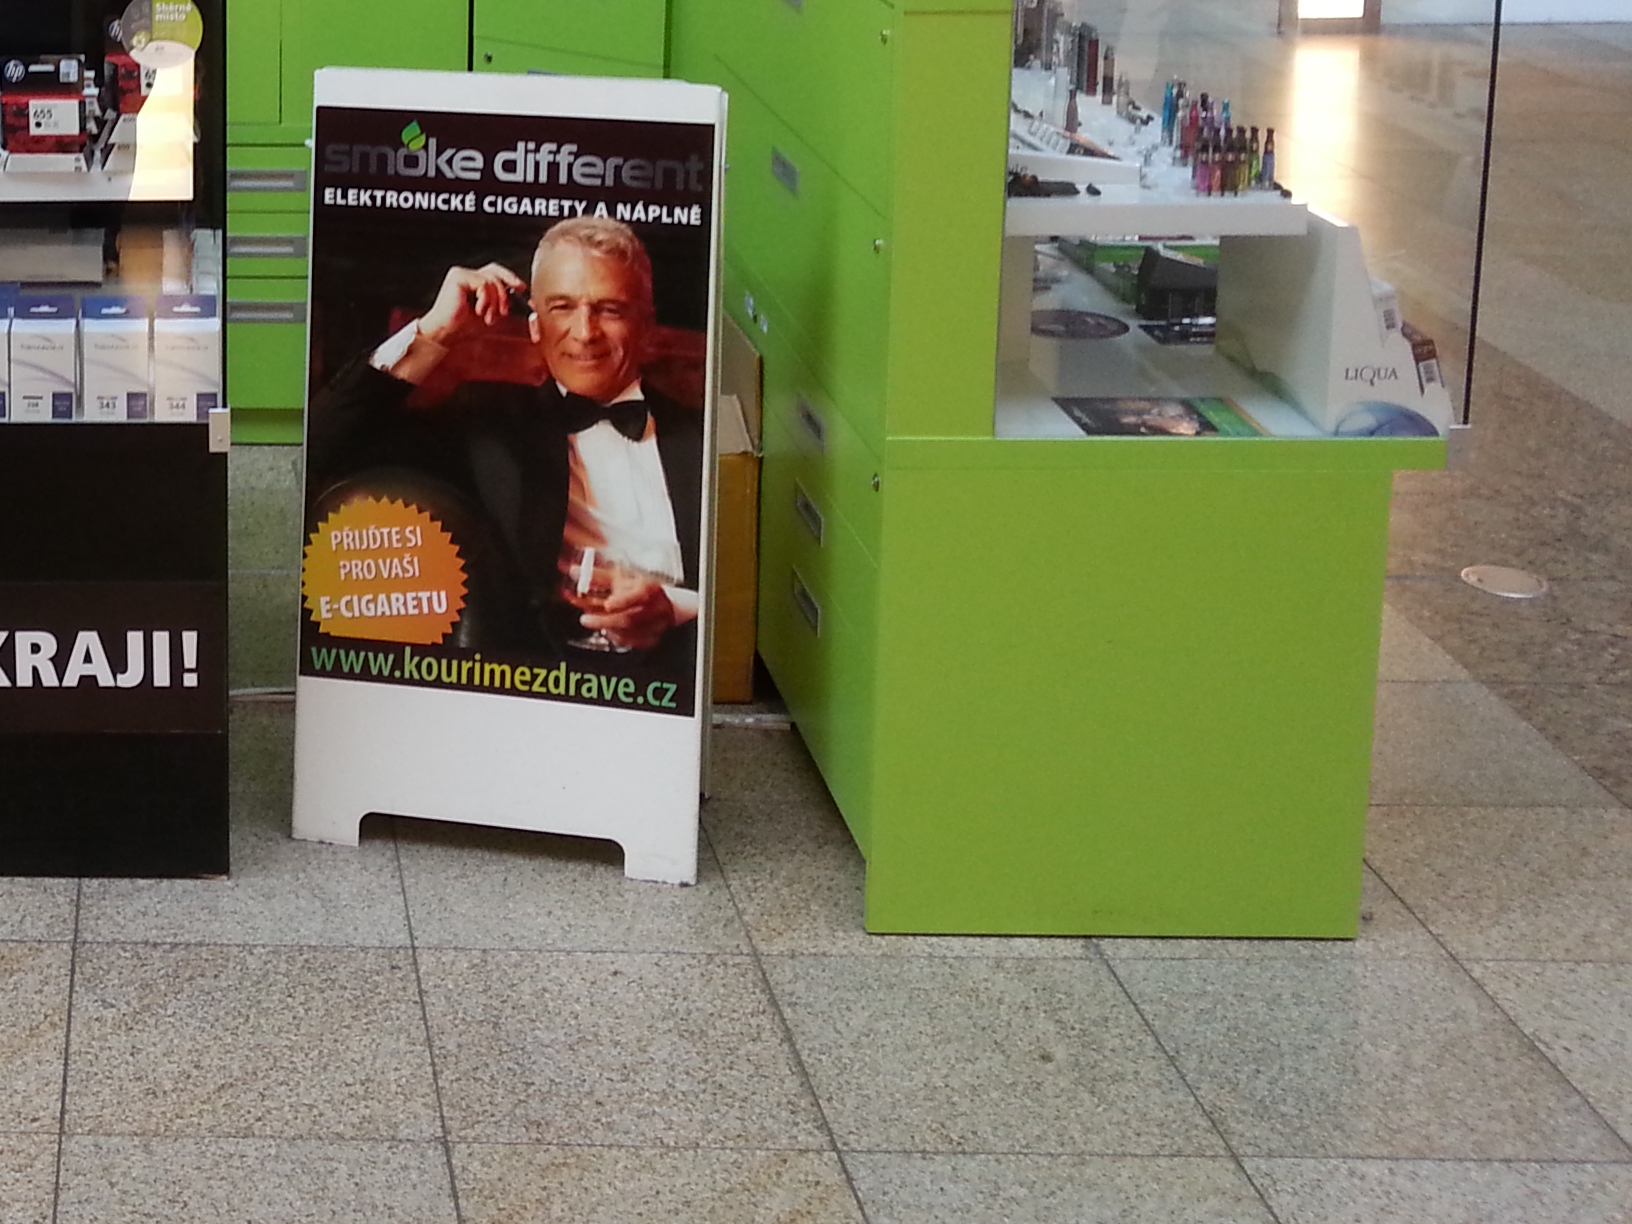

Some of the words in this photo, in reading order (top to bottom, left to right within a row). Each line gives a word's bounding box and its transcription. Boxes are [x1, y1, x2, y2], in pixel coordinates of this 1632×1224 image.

[324, 137, 485, 182] smoke
[492, 140, 705, 192] different
[323, 186, 477, 214] ELEKTRONICKÉ
[482, 195, 590, 219] CIGARETY
[593, 200, 609, 220] A
[616, 199, 703, 226] NÁPLNĚ
[1343, 364, 1399, 388] LIQUA
[329, 525, 402, 552] PŘIJĎTE
[404, 524, 423, 546] SI
[338, 558, 376, 582] PRO
[378, 554, 420, 579] VAŠI
[318, 589, 449, 620] E-CIGARETU
[310, 644, 678, 709] www.kourimezdrave.cz
